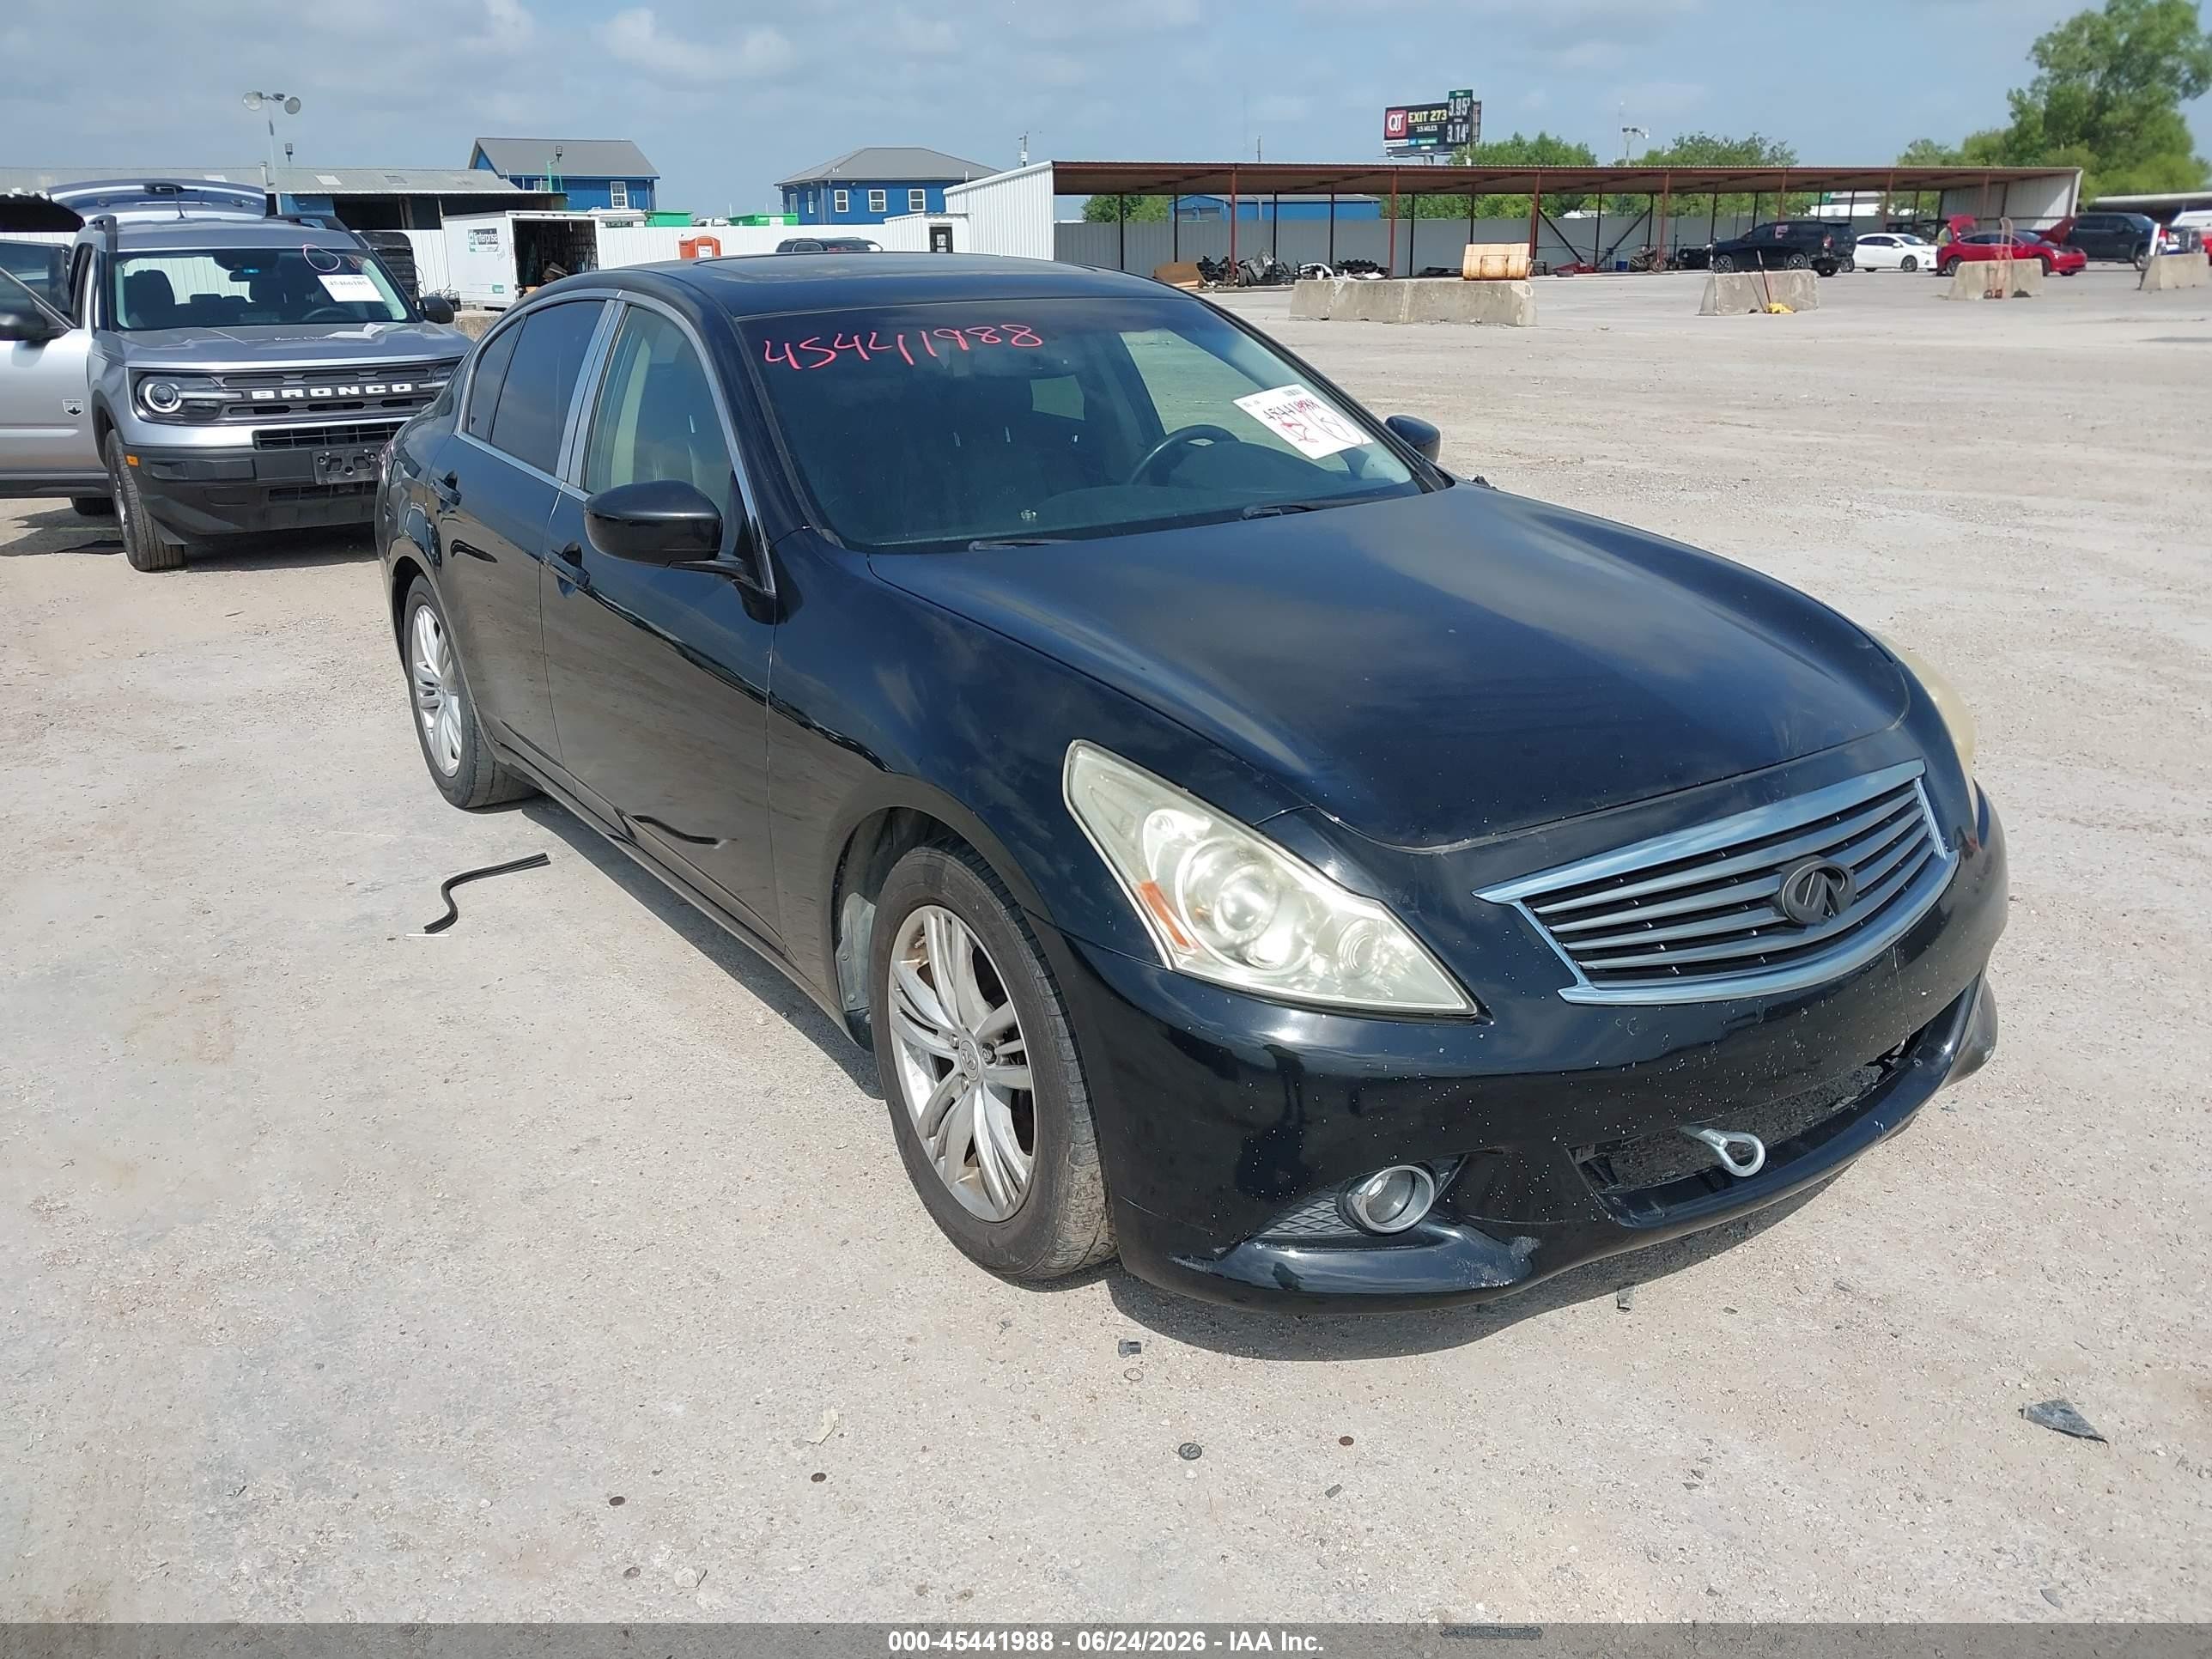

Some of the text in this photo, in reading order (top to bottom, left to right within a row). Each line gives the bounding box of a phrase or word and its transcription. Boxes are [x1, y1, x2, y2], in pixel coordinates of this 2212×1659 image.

[1388, 113, 1403, 132] QT
[1408, 109, 1448, 123] EXIT 273
[763, 324, 1043, 370] 45441988
[252, 383, 412, 399] BRONCO
